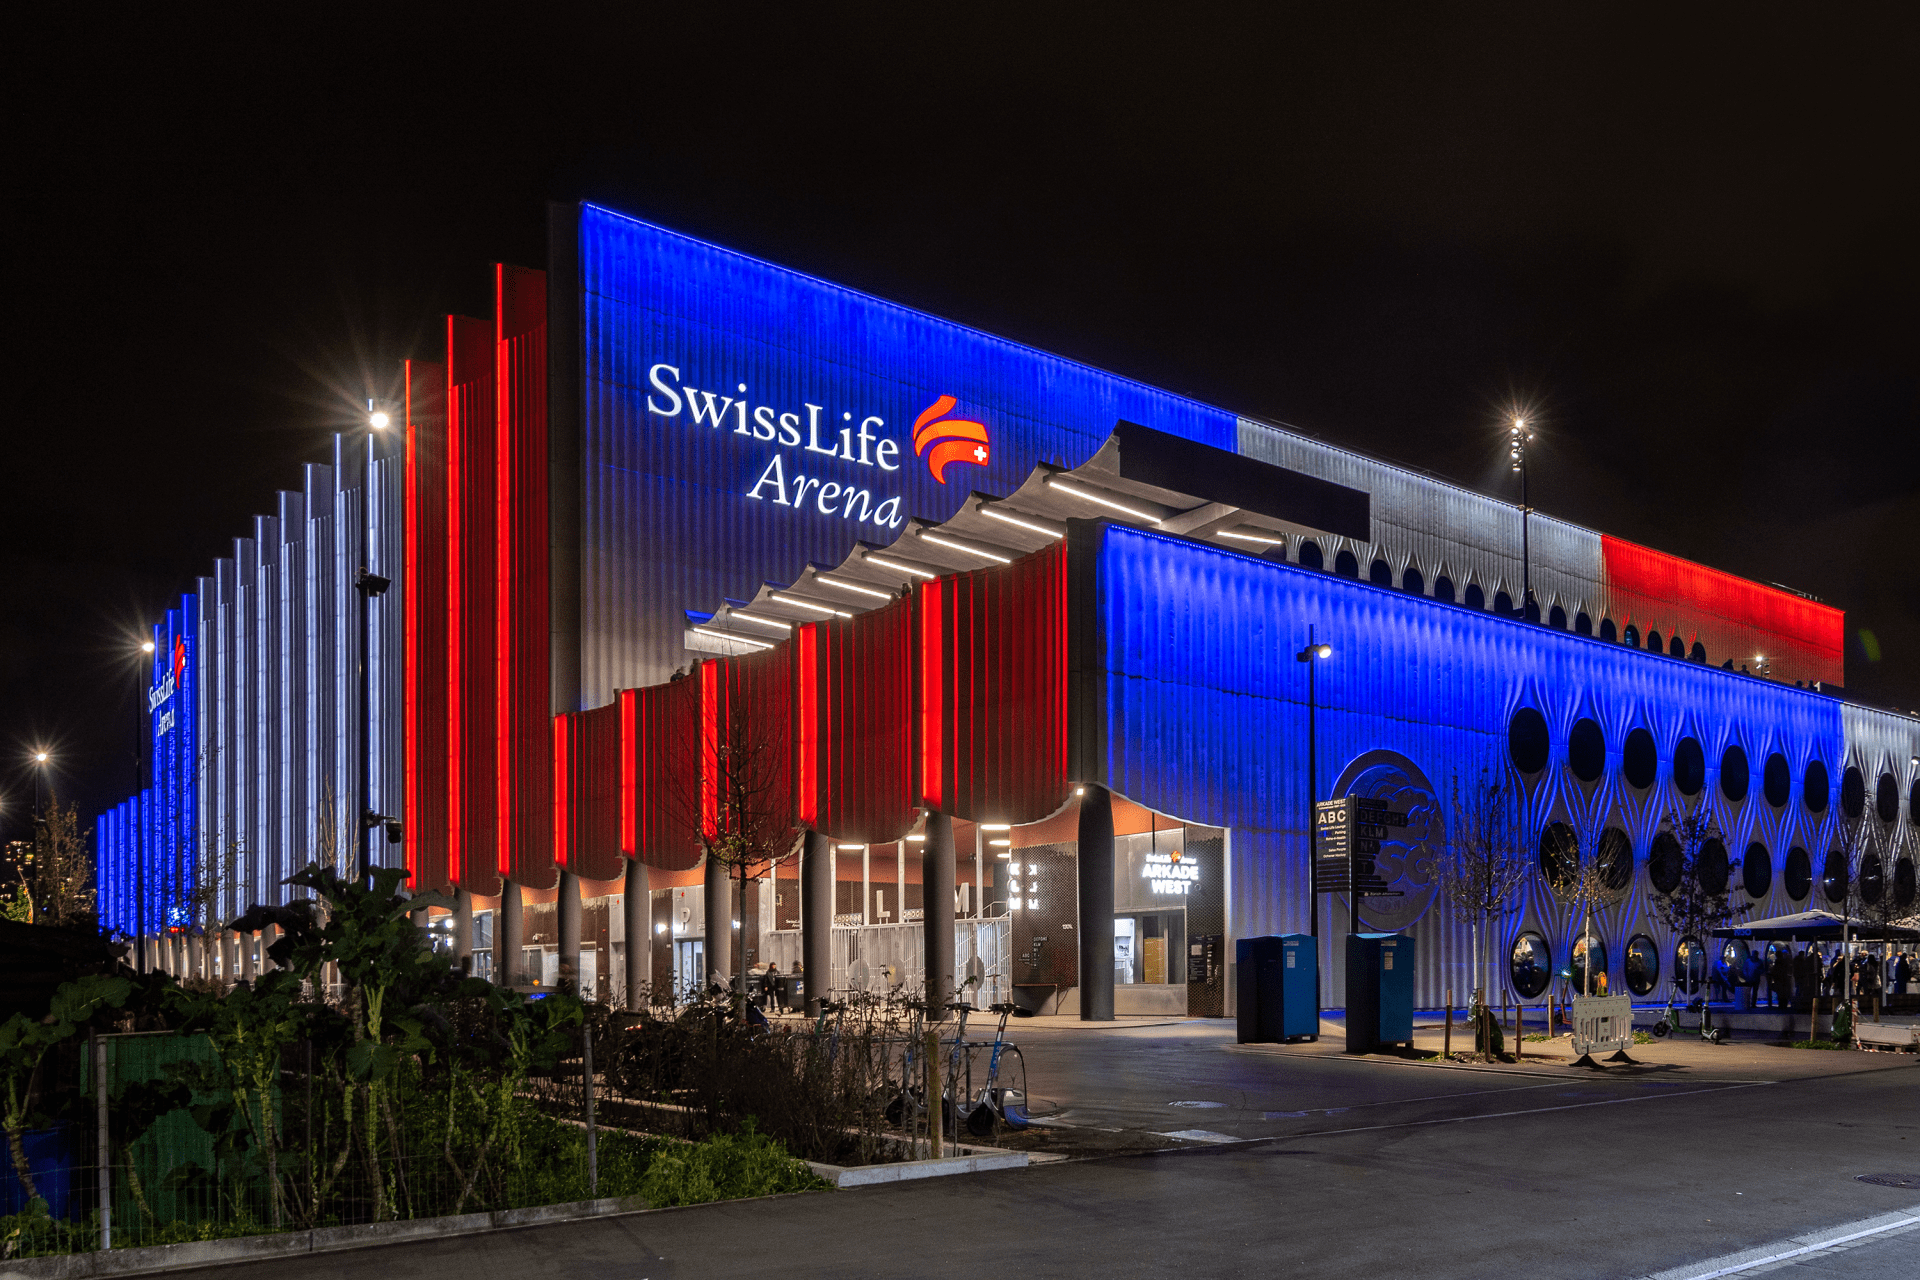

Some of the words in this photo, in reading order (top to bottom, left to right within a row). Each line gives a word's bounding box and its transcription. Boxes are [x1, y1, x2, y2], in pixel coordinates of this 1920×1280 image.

[648, 363, 900, 471] SwissLife
[746, 453, 902, 529] Arena
[1317, 809, 1346, 824] ABC
[1142, 863, 1199, 880] ARKADE
[1151, 879, 1191, 894] WEST
[876, 889, 890, 918] L
